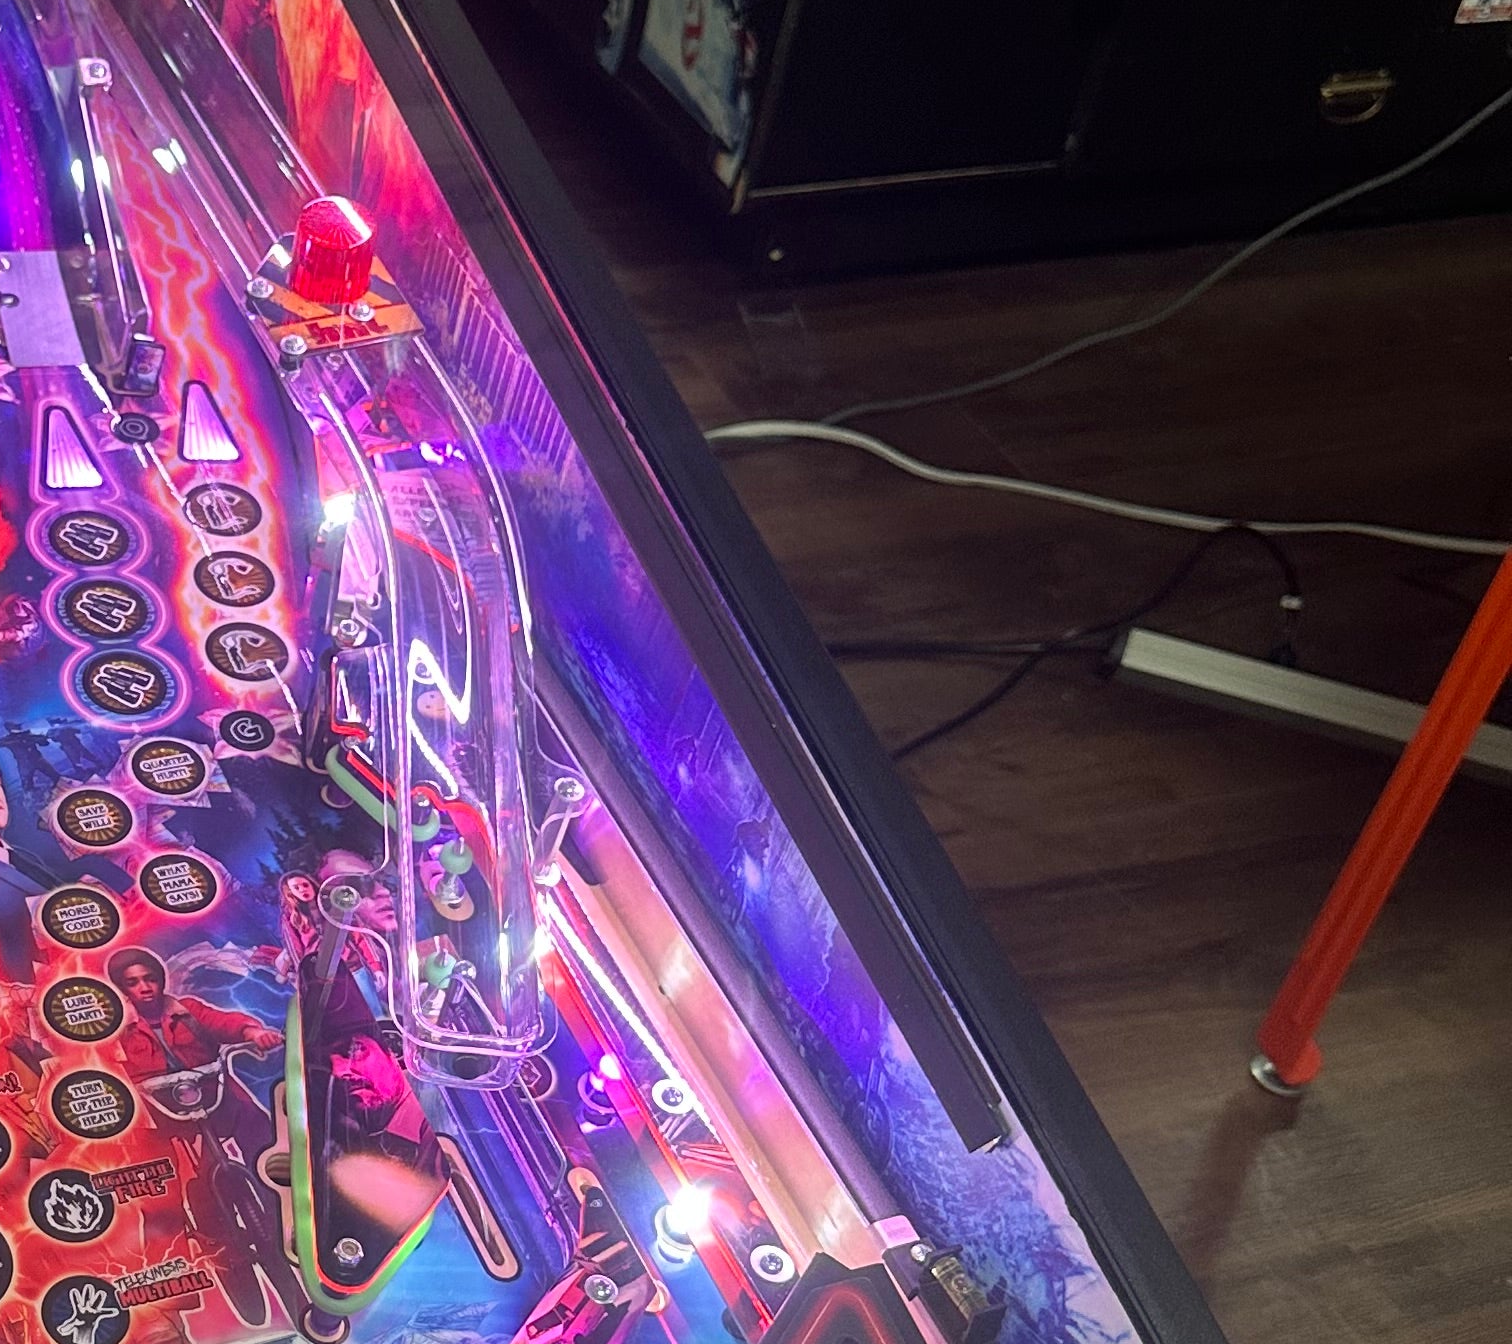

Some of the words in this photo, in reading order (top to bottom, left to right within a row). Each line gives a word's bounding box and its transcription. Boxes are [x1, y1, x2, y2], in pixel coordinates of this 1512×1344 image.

[141, 754, 191, 771] QUARTER
[77, 804, 107, 817] SAVE
[155, 863, 188, 876] WHAT
[162, 877, 195, 890] MAMA
[168, 890, 200, 904] SAYS!
[58, 904, 99, 919] MORSE
[65, 918, 102, 932] CODE!
[70, 1082, 104, 1096] TURN
[72, 1101, 89, 1113] UP
[90, 1095, 115, 1109] THE
[81, 1112, 118, 1128] HEAT!
[115, 1177, 168, 1204] FIRE
[113, 1259, 189, 1291] TELEKINESIS
[118, 1270, 214, 1307] MULTIBALL
